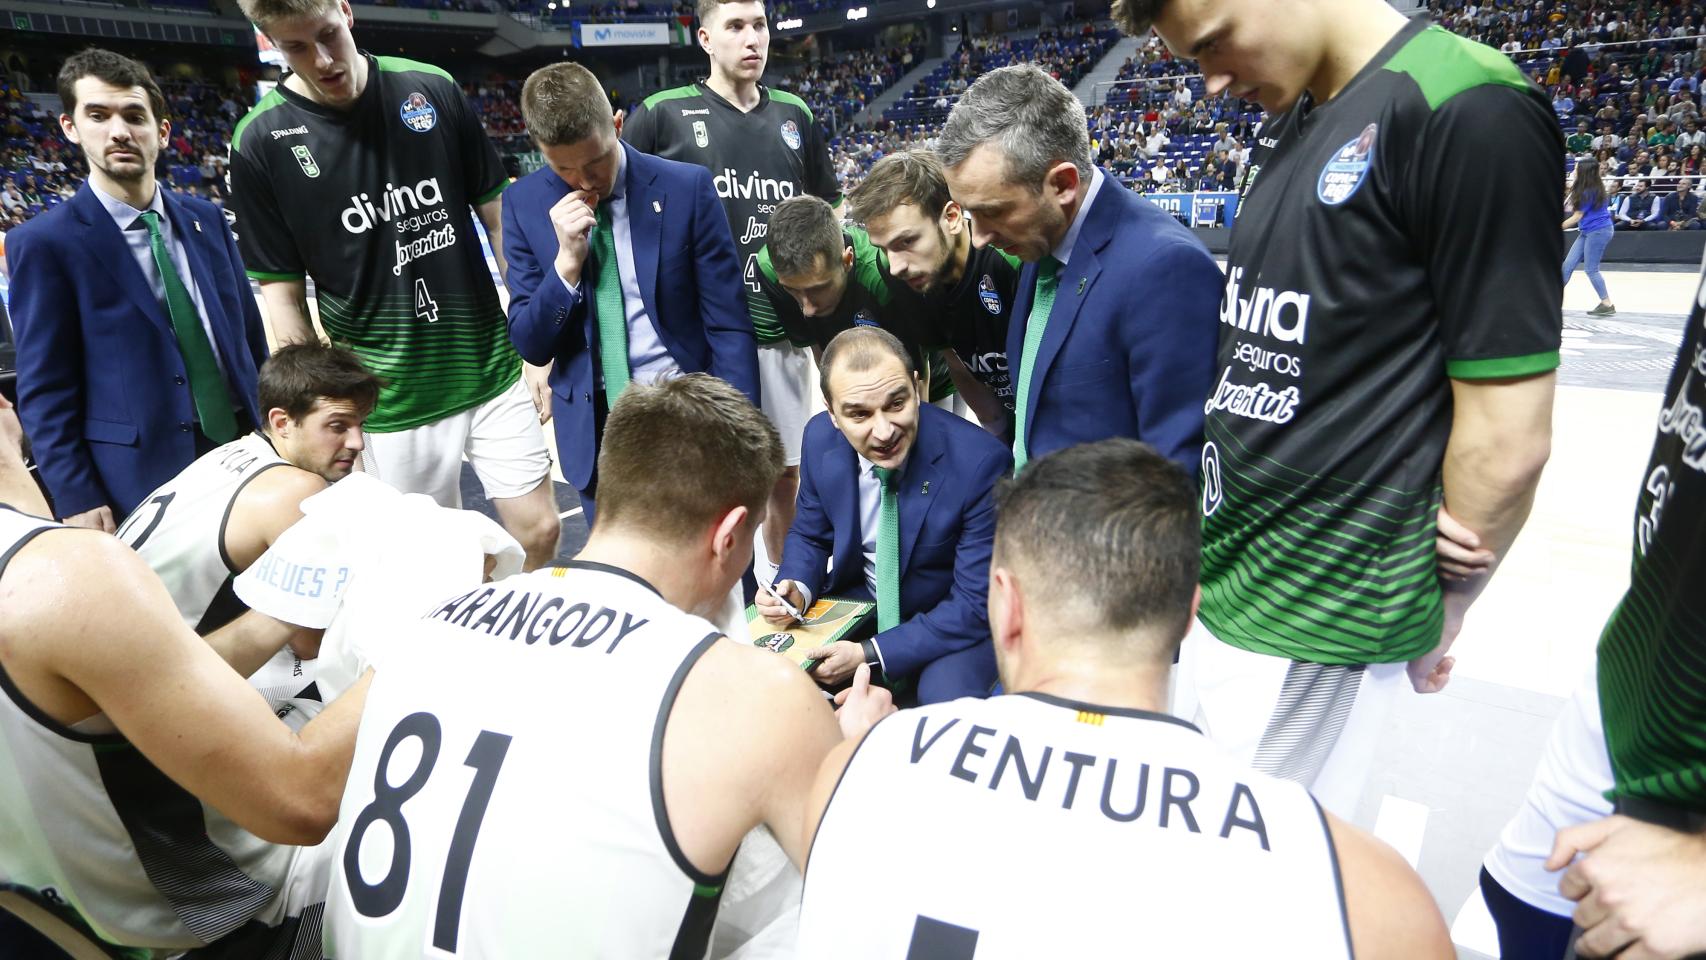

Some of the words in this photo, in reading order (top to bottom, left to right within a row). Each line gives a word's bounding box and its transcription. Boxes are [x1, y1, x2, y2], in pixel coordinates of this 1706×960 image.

[613, 29, 656, 40] movistar
[270, 125, 309, 140] SPALDING
[713, 168, 794, 200] divina
[341, 177, 443, 234] divina
[396, 208, 449, 233] seguros
[744, 253, 761, 292] 4
[415, 278, 439, 323] 4
[1233, 341, 1301, 377] seguros
[1205, 366, 1300, 424] Jventut
[910, 716, 1271, 851] VENTURA
[343, 711, 514, 954] 81
